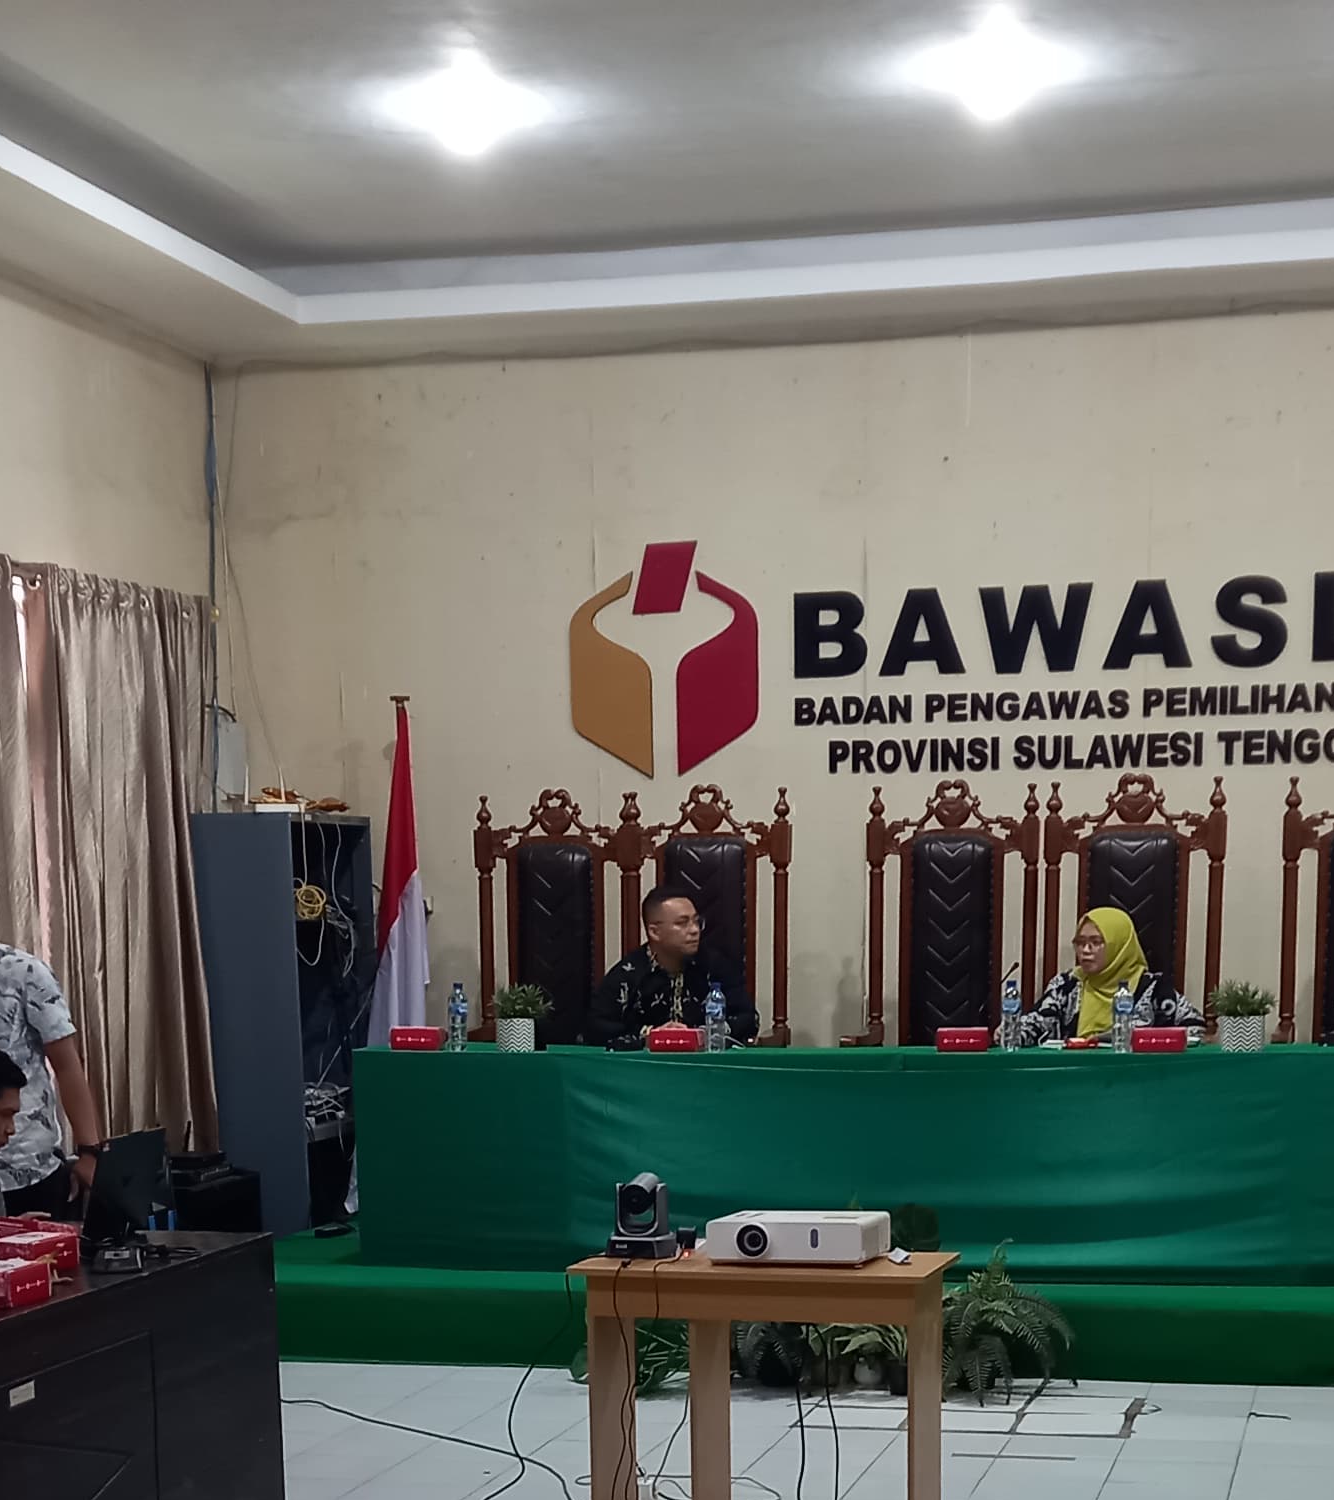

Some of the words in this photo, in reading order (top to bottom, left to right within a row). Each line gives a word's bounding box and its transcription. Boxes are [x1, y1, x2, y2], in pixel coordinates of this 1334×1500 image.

[793, 694, 913, 727] BADAN
[924, 688, 1131, 723] PENGAWAS
[828, 735, 1000, 774] PROVINSI
[1012, 731, 1204, 770] SULAWESI
